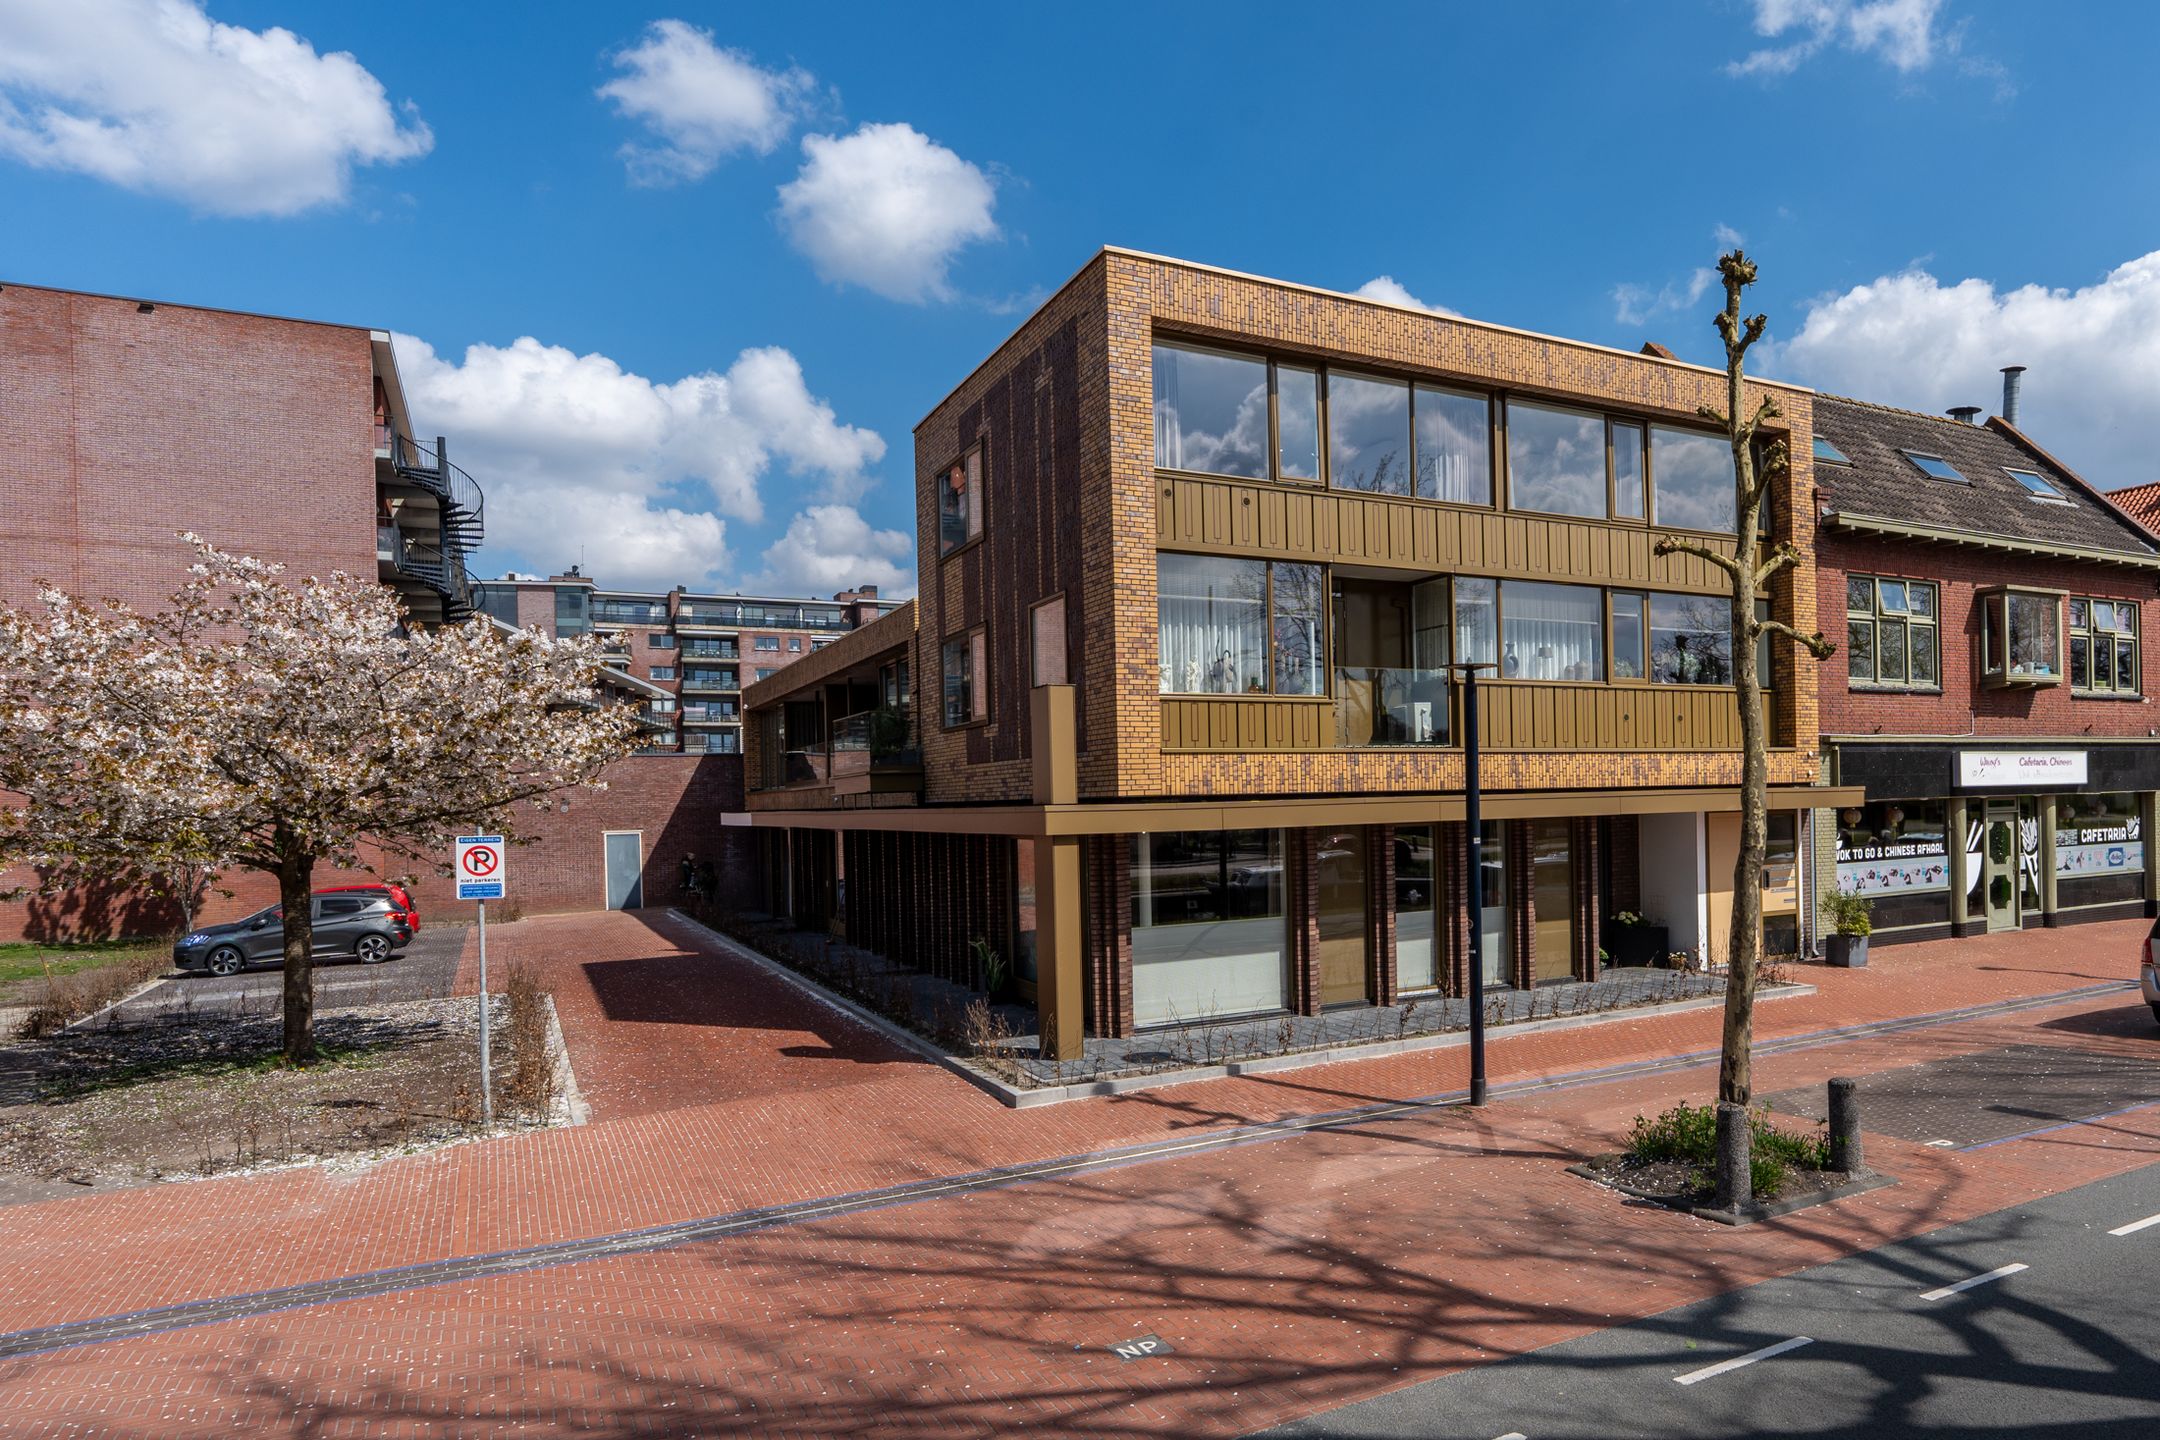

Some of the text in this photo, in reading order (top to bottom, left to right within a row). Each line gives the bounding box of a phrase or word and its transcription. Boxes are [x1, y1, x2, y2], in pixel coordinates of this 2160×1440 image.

[2081, 827, 2127, 843] CAFETARIA
[1852, 848, 1863, 860] TO
[1865, 847, 1875, 859] GO
[1877, 846, 1883, 858] &
[1885, 844, 1916, 857] CHINESE
[1917, 842, 1945, 855] AFHAAL
[474, 851, 490, 871] P
[1116, 1341, 1157, 1359] NP
